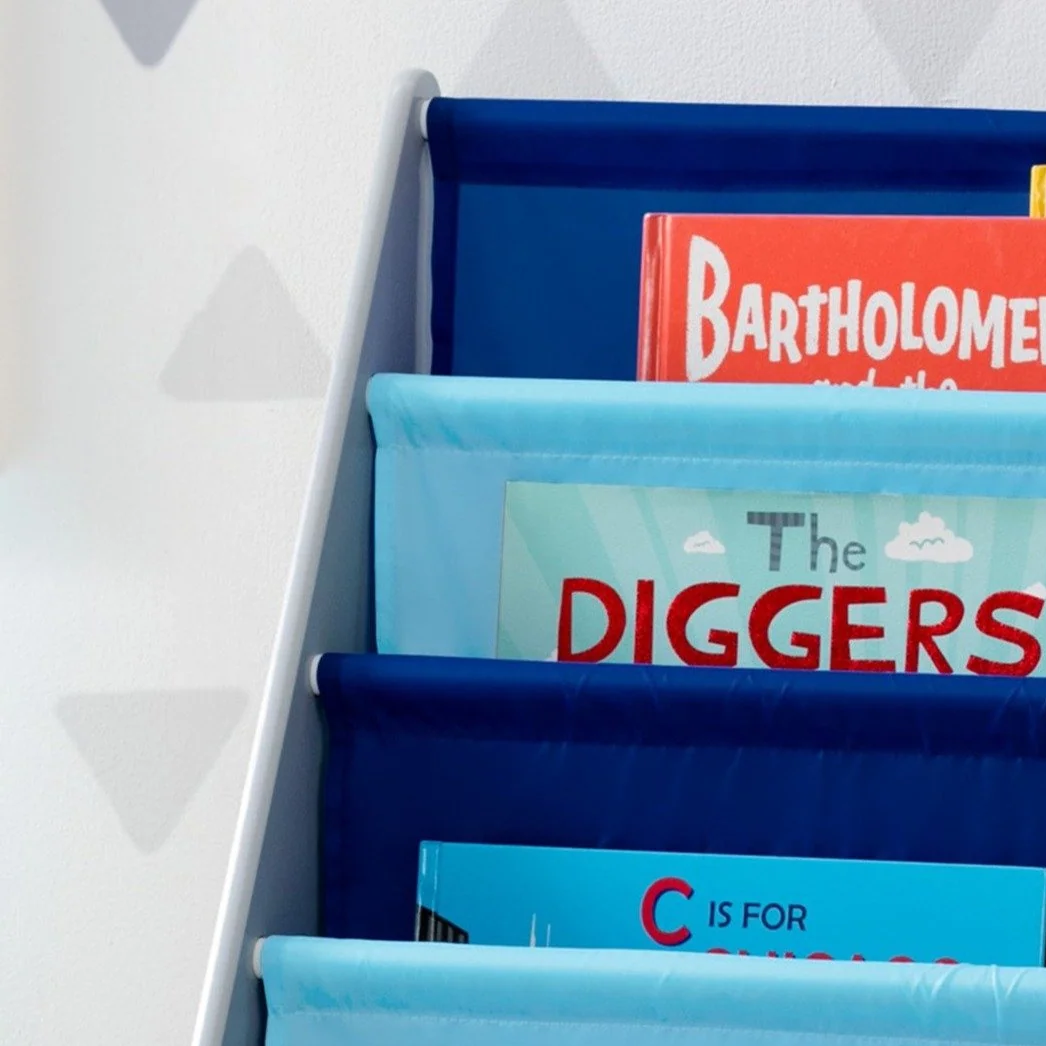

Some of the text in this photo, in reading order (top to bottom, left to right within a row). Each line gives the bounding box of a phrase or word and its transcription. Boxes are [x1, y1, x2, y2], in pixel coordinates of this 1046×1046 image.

[746, 511, 867, 573] The
[556, 577, 1046, 678] DIGGERS
[640, 876, 807, 947] C IS FOR
